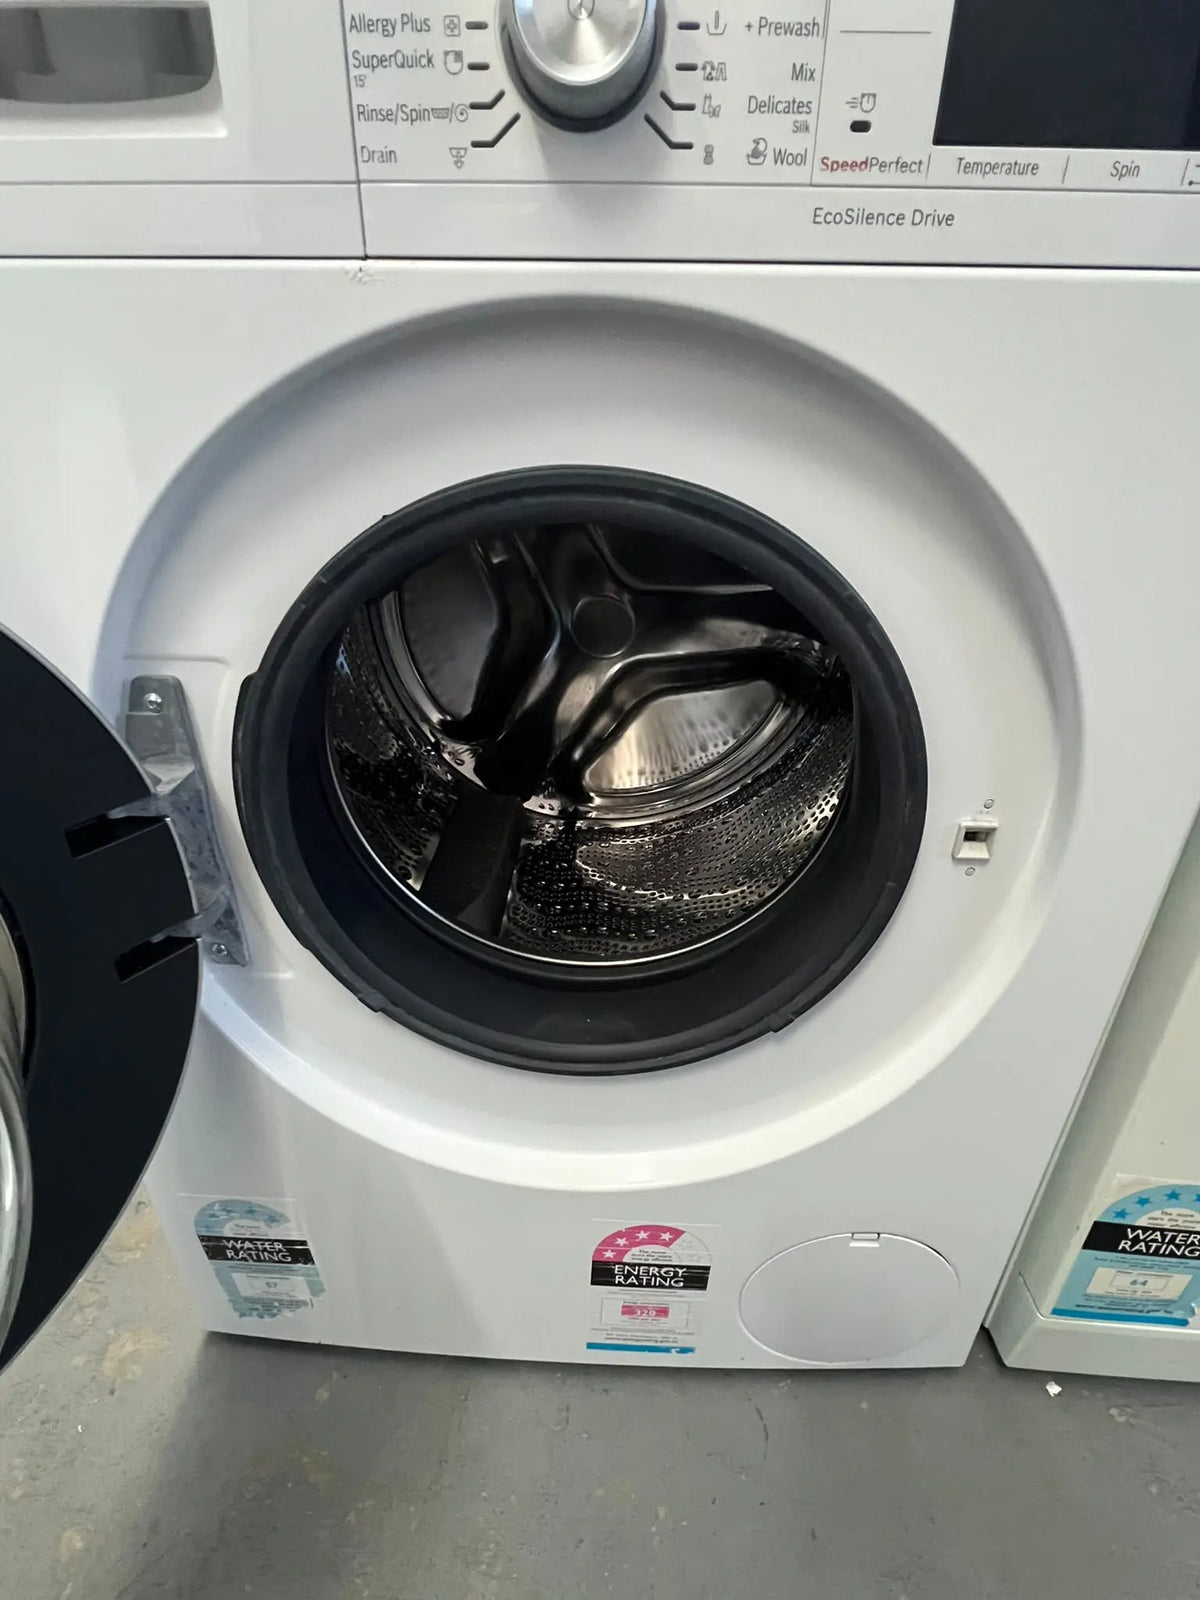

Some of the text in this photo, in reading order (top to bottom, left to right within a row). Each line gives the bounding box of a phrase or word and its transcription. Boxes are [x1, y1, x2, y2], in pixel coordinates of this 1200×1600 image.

[349, 12, 431, 37] Allergy Plus
[757, 16, 820, 38] Prewash
[352, 49, 434, 73] SuperQuick
[791, 62, 816, 82] Mix
[356, 103, 431, 125] Rinse/Spin
[747, 95, 812, 115] Delicates
[792, 119, 810, 134] Silk
[360, 145, 397, 163] Drain
[773, 148, 807, 166] Wool
[820, 156, 922, 174] SpeedPerfect
[956, 157, 1039, 178] Temperature
[1110, 160, 1141, 181] Spin
[812, 207, 955, 226] EcoSilence Drive
[1127, 1227, 1200, 1245] WATER
[222, 1239, 287, 1252] WATER
[1118, 1240, 1200, 1257] RATING
[226, 1249, 292, 1263] RATING
[614, 1264, 687, 1277] ENERGY
[615, 1275, 684, 1287] RATING
